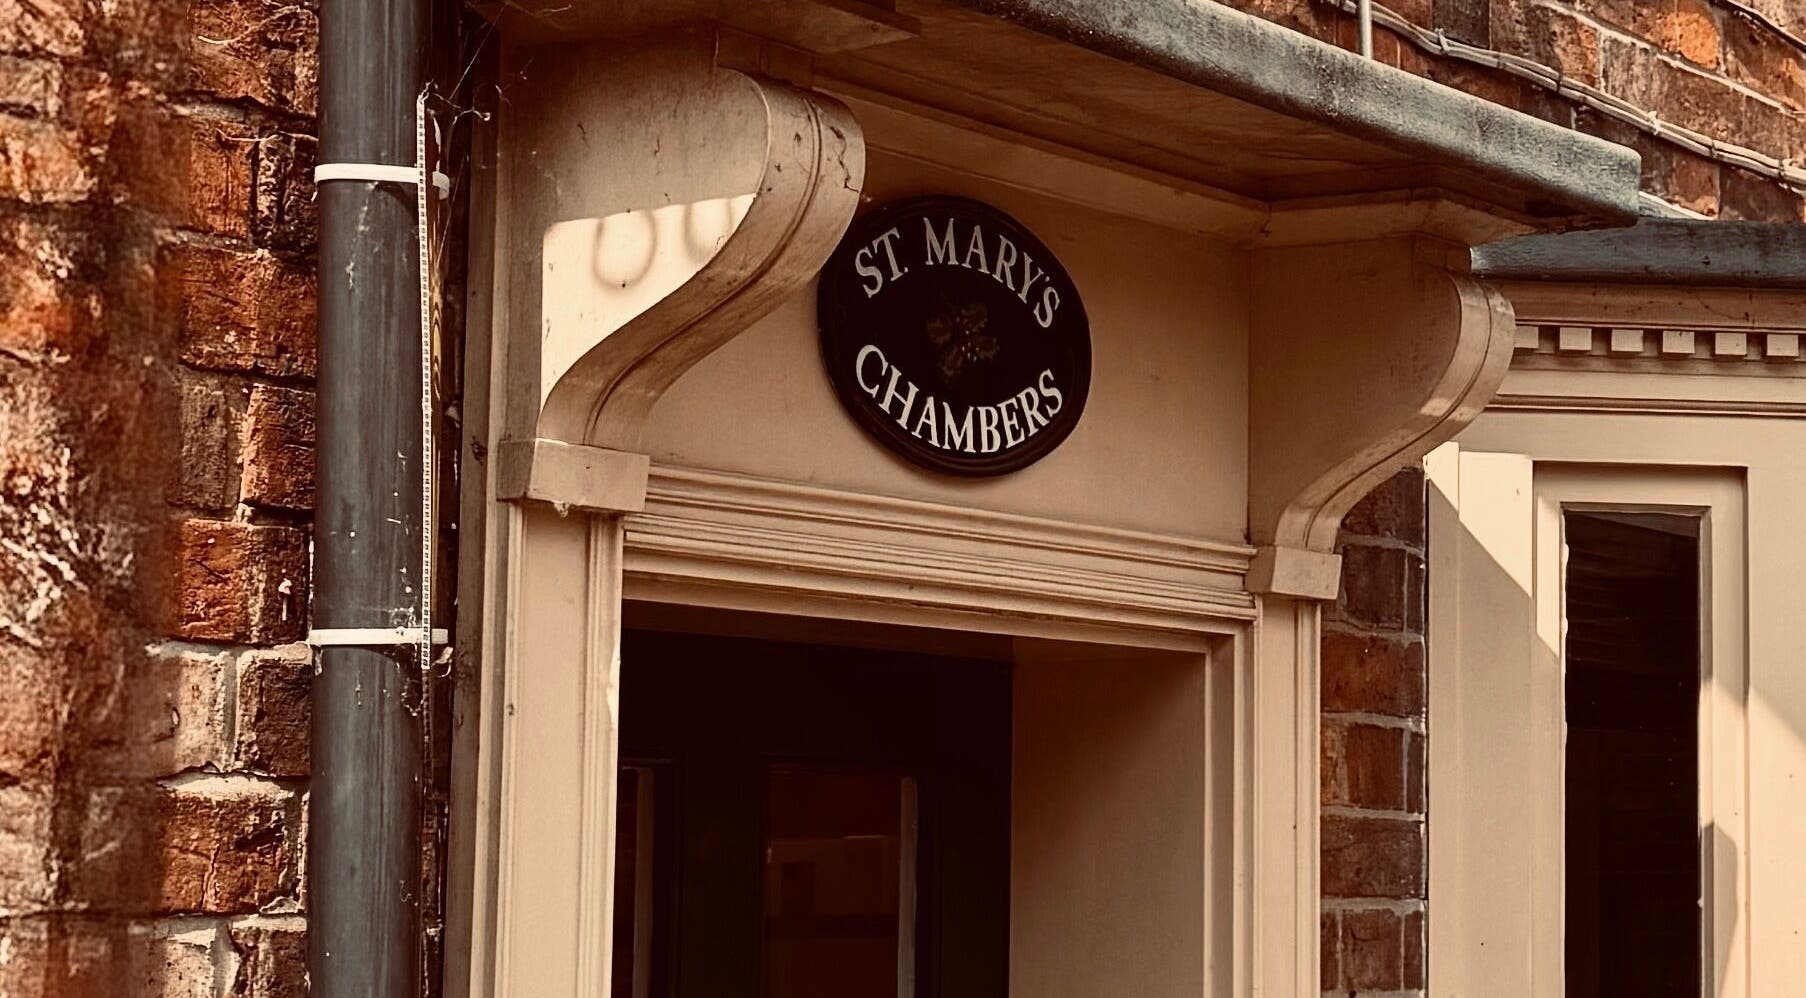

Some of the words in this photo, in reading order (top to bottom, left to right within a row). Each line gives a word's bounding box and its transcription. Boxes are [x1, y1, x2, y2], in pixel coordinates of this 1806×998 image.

[855, 227, 909, 298] ST.
[923, 217, 1060, 328] MARY'S
[855, 345, 1063, 453] CHAMBERS
